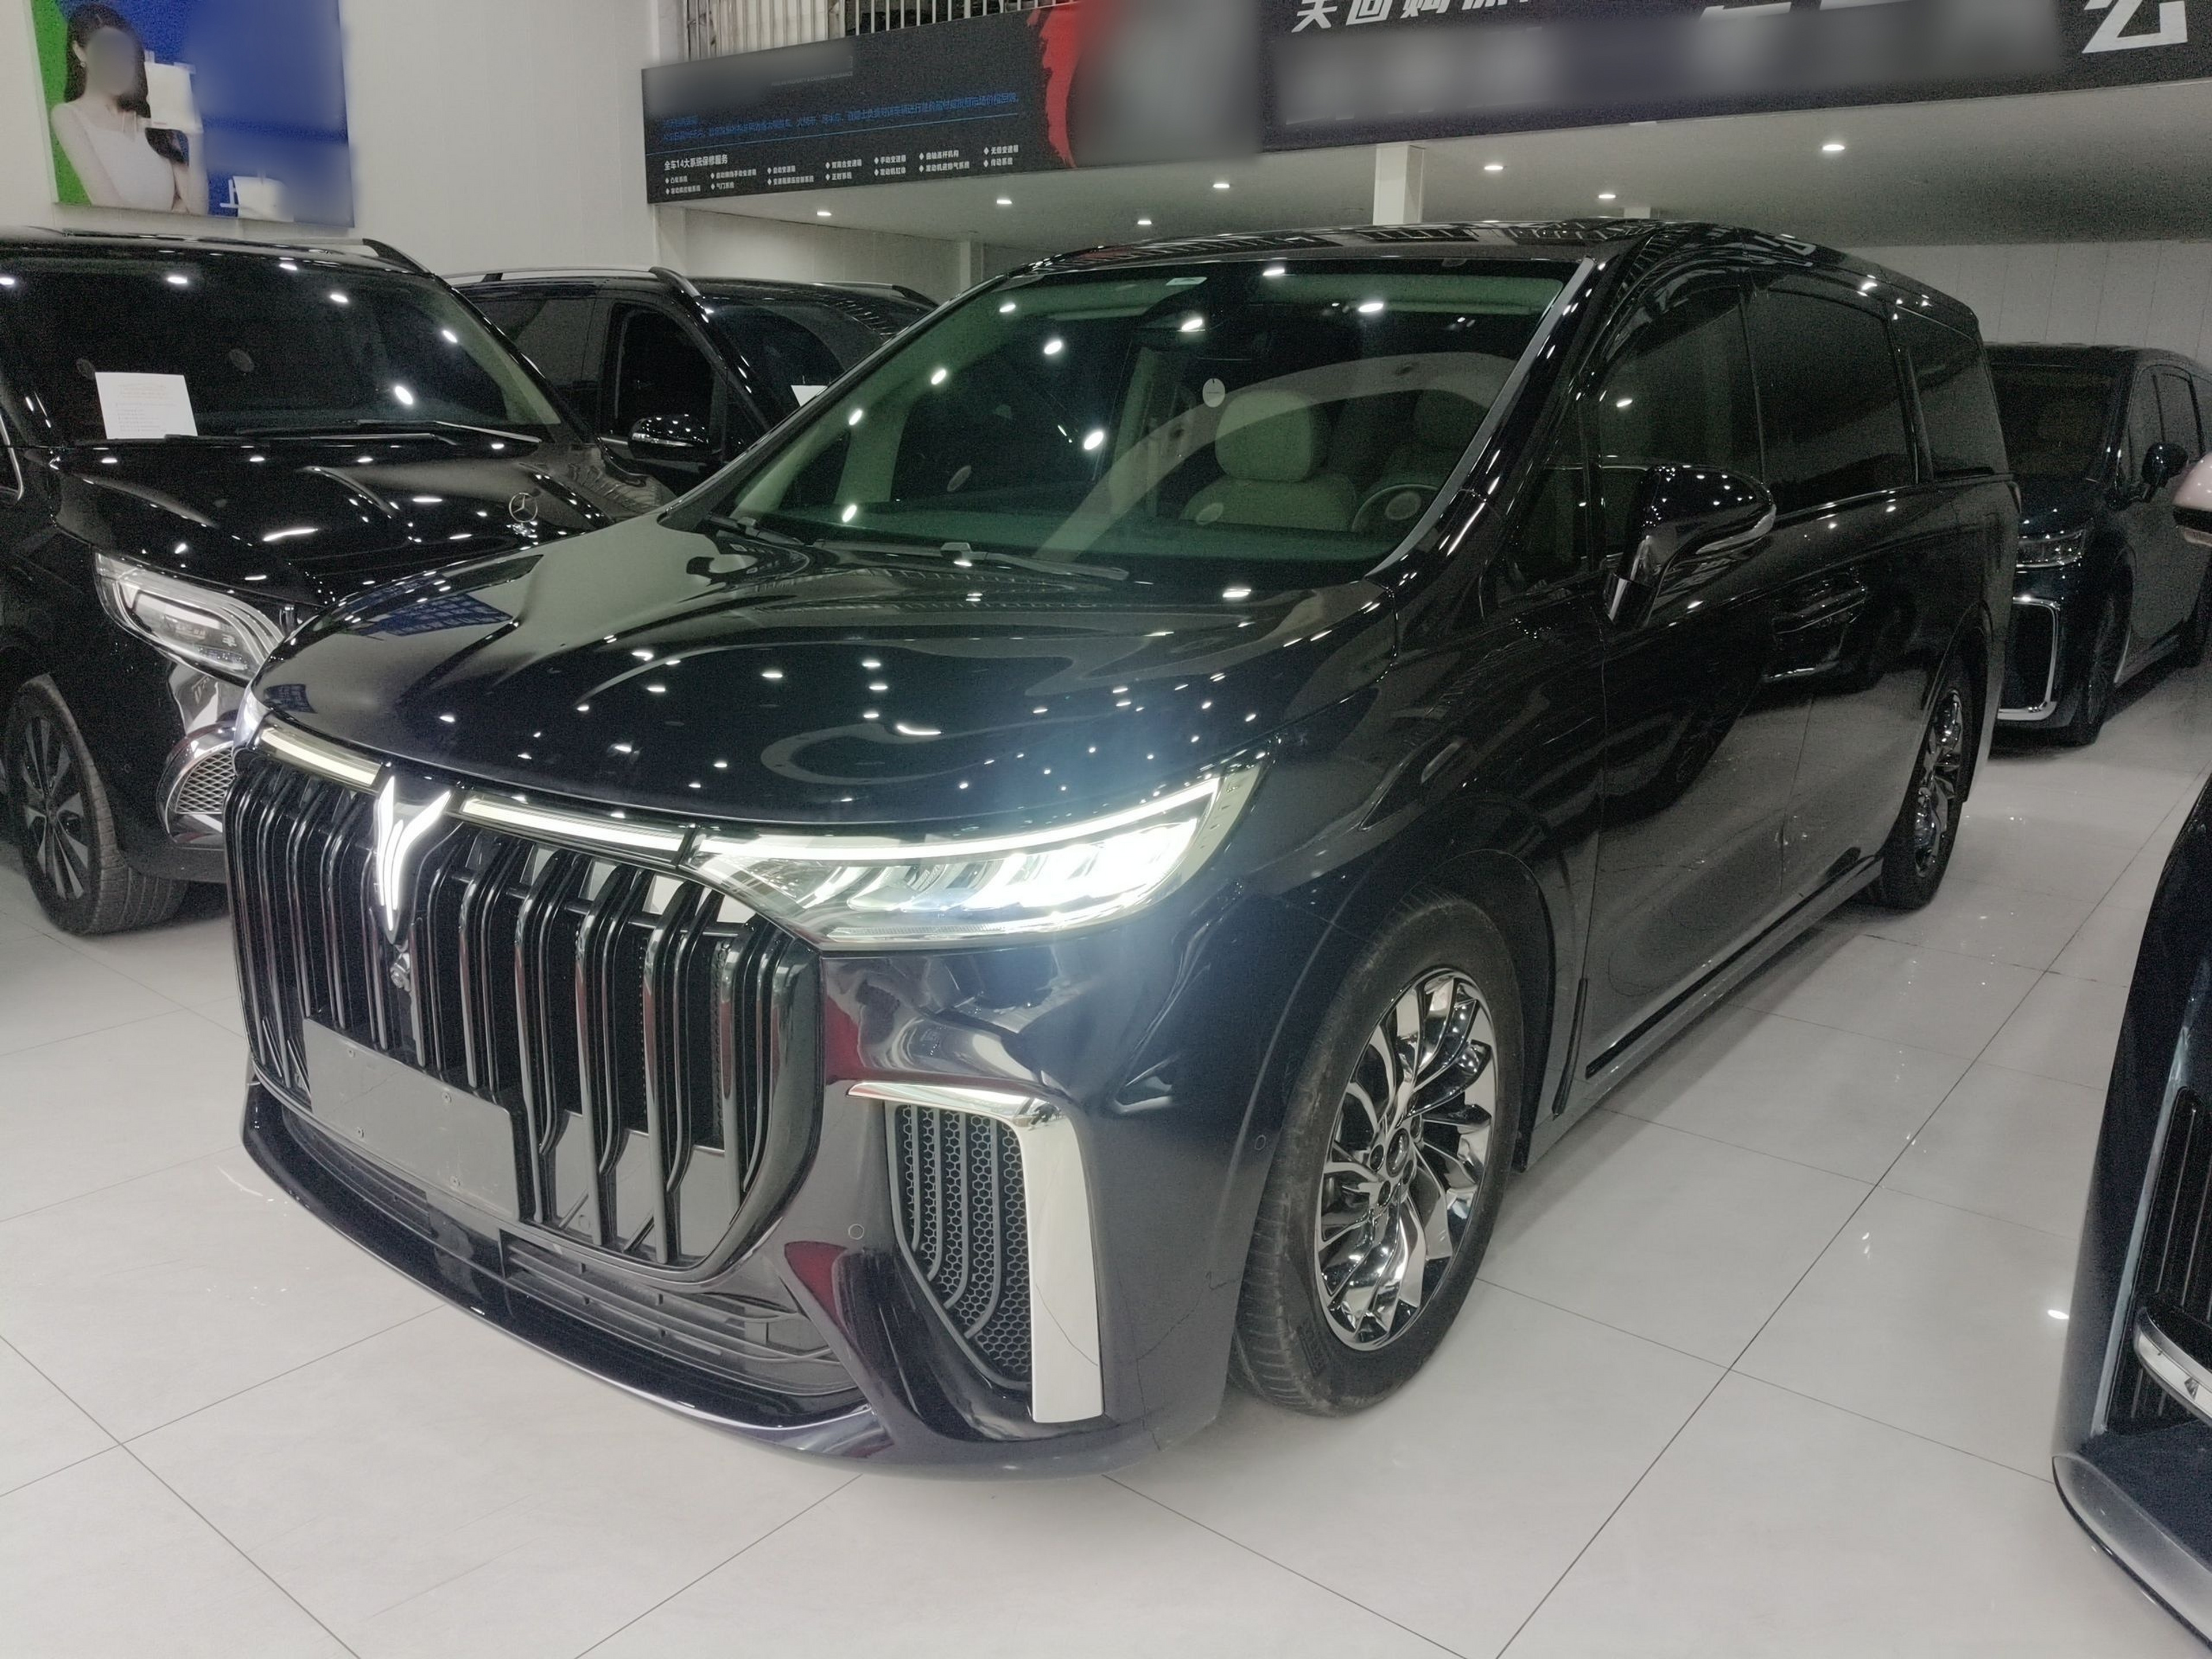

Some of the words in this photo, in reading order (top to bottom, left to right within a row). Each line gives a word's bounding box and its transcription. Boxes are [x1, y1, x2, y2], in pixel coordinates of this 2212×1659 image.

[664, 154, 728, 171] 全车14大系统保修服务
